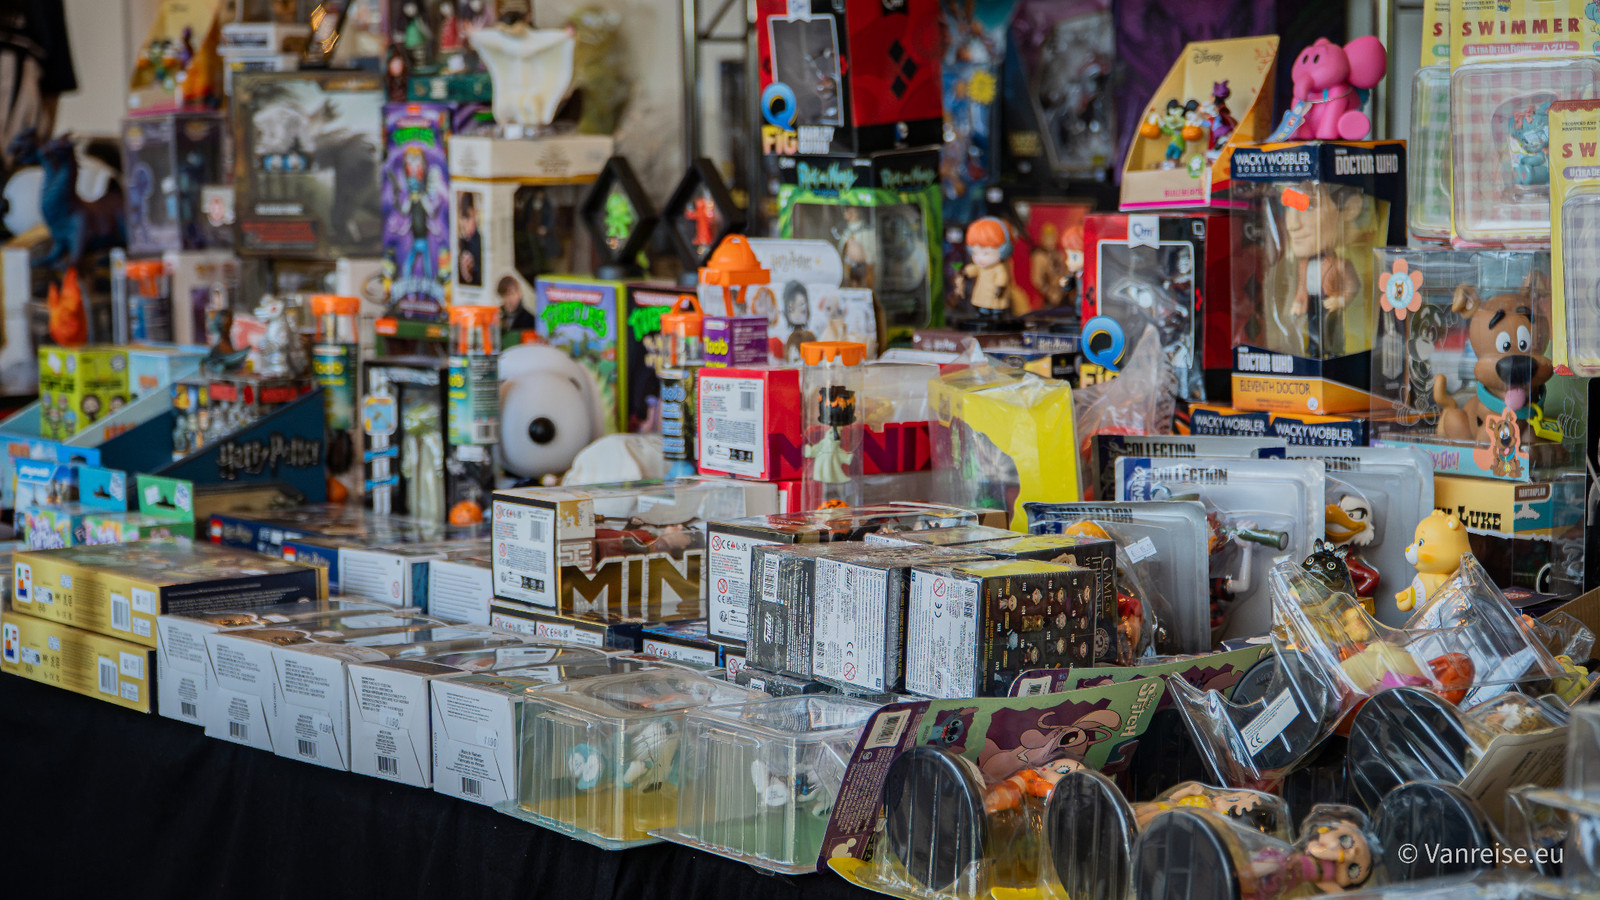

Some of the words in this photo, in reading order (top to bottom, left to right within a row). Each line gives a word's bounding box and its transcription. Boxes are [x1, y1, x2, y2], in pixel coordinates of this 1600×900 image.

[1462, 17, 1580, 37] SWIMMER
[1468, 46, 1488, 56] ULTRA
[1488, 45, 1510, 56] DETAIL
[1234, 152, 1267, 166] WACKY
[1267, 151, 1312, 166] WOBBLER
[1335, 154, 1375, 176] DOCTOR
[1375, 153, 1399, 174] WHO
[1237, 165, 1309, 173] BOBBLE-HEAD
[1237, 353, 1271, 372] DOCTOR
[1271, 354, 1294, 374] WHO
[1240, 380, 1275, 393] ELEVENTH
[1276, 381, 1311, 396] DOCTOR
[1194, 414, 1223, 430] WACKY
[1223, 416, 1266, 432] WOBBLER
[1275, 422, 1308, 438] WACKY
[1308, 426, 1355, 442] WOBBLER
[1124, 442, 1196, 458] COLLECTION
[1152, 467, 1228, 486] COLLECTION
[1457, 504, 1501, 530] LUKE
[1102, 556, 1114, 600] GAME
[763, 611, 773, 644] Funko
